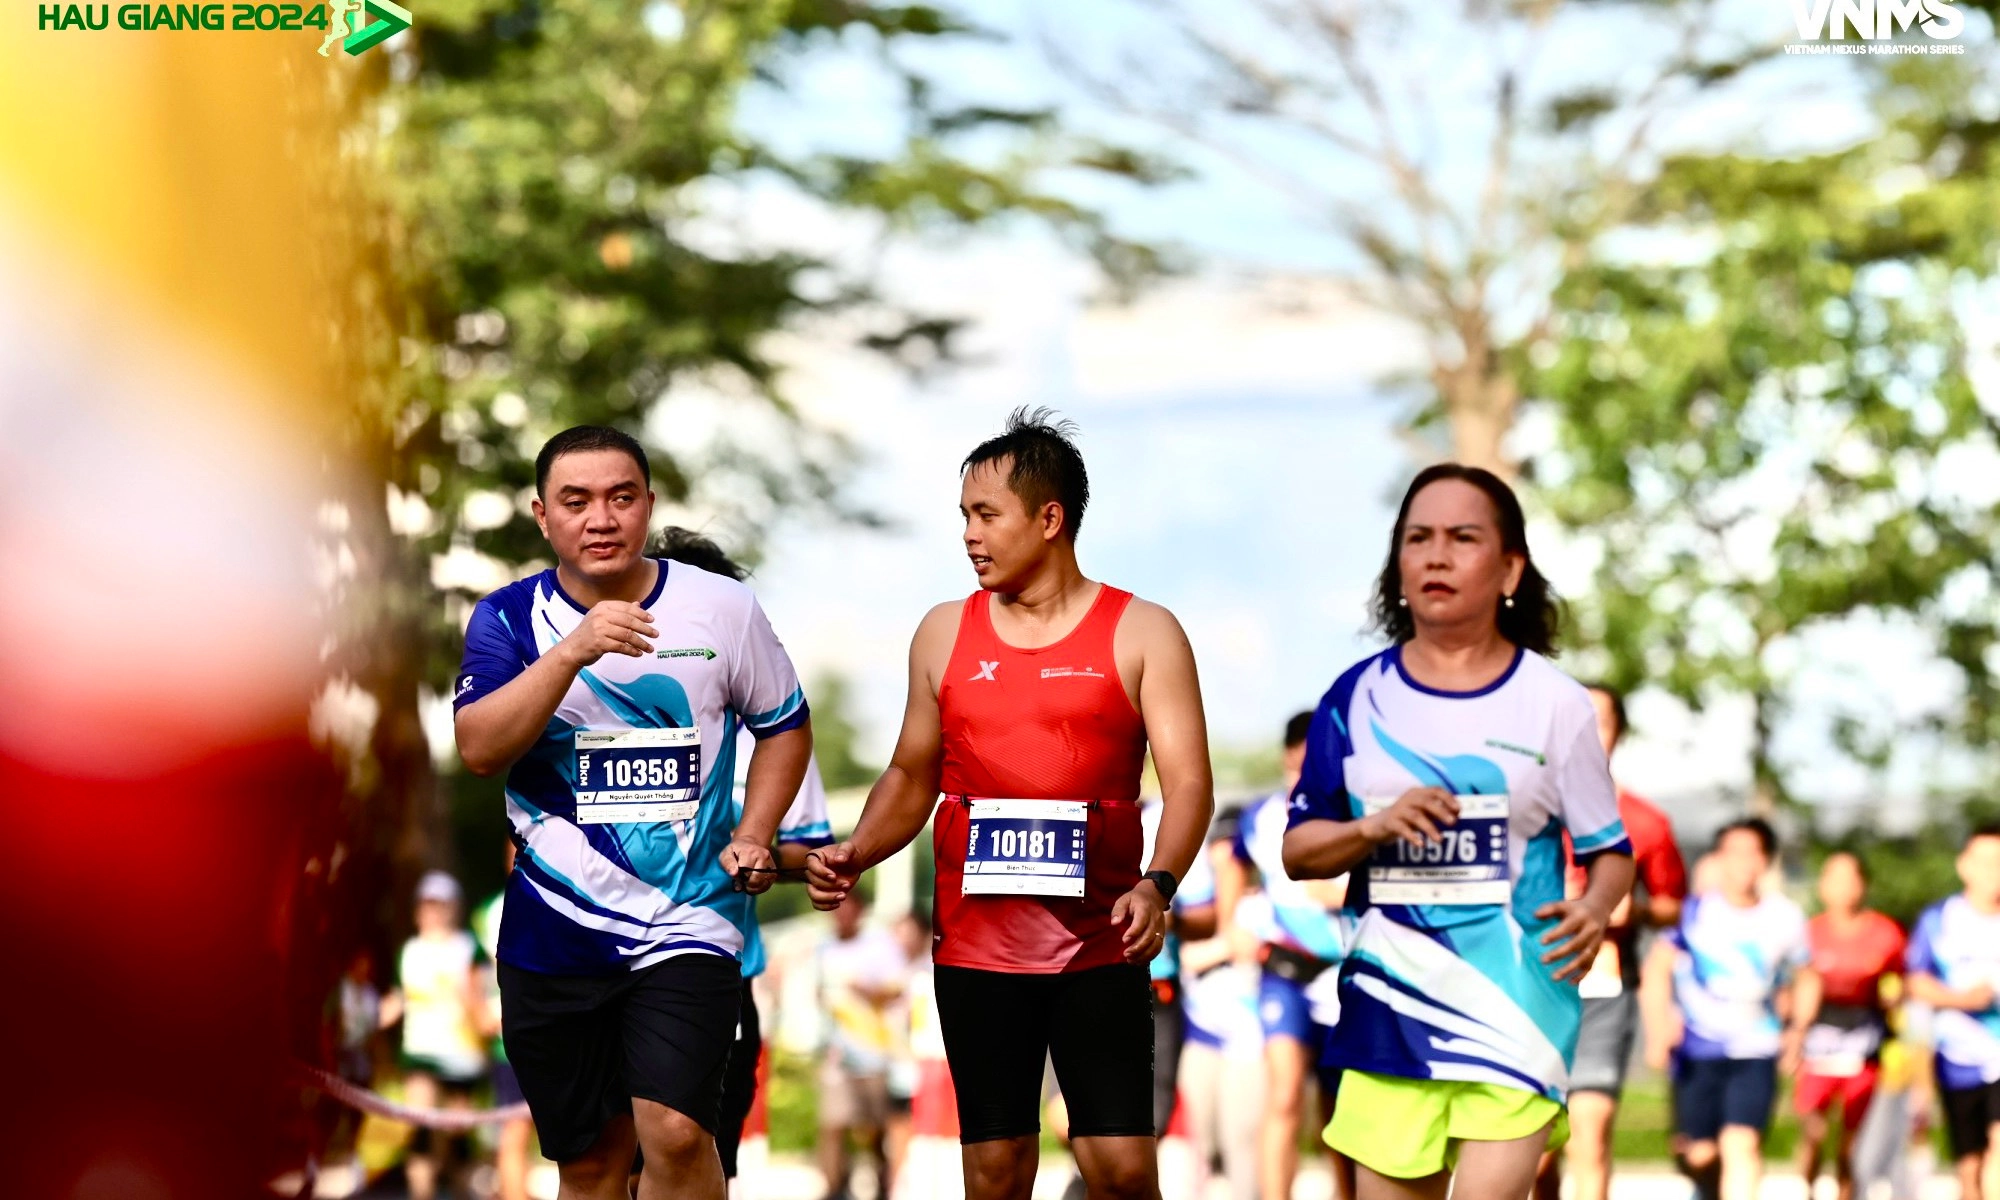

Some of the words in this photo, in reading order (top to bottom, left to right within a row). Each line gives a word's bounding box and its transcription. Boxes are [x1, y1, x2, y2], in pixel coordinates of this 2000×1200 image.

[579, 754, 590, 787] 10KM
[603, 758, 679, 787] 10358
[968, 824, 980, 856] 10KM
[990, 829, 1056, 859] 10181
